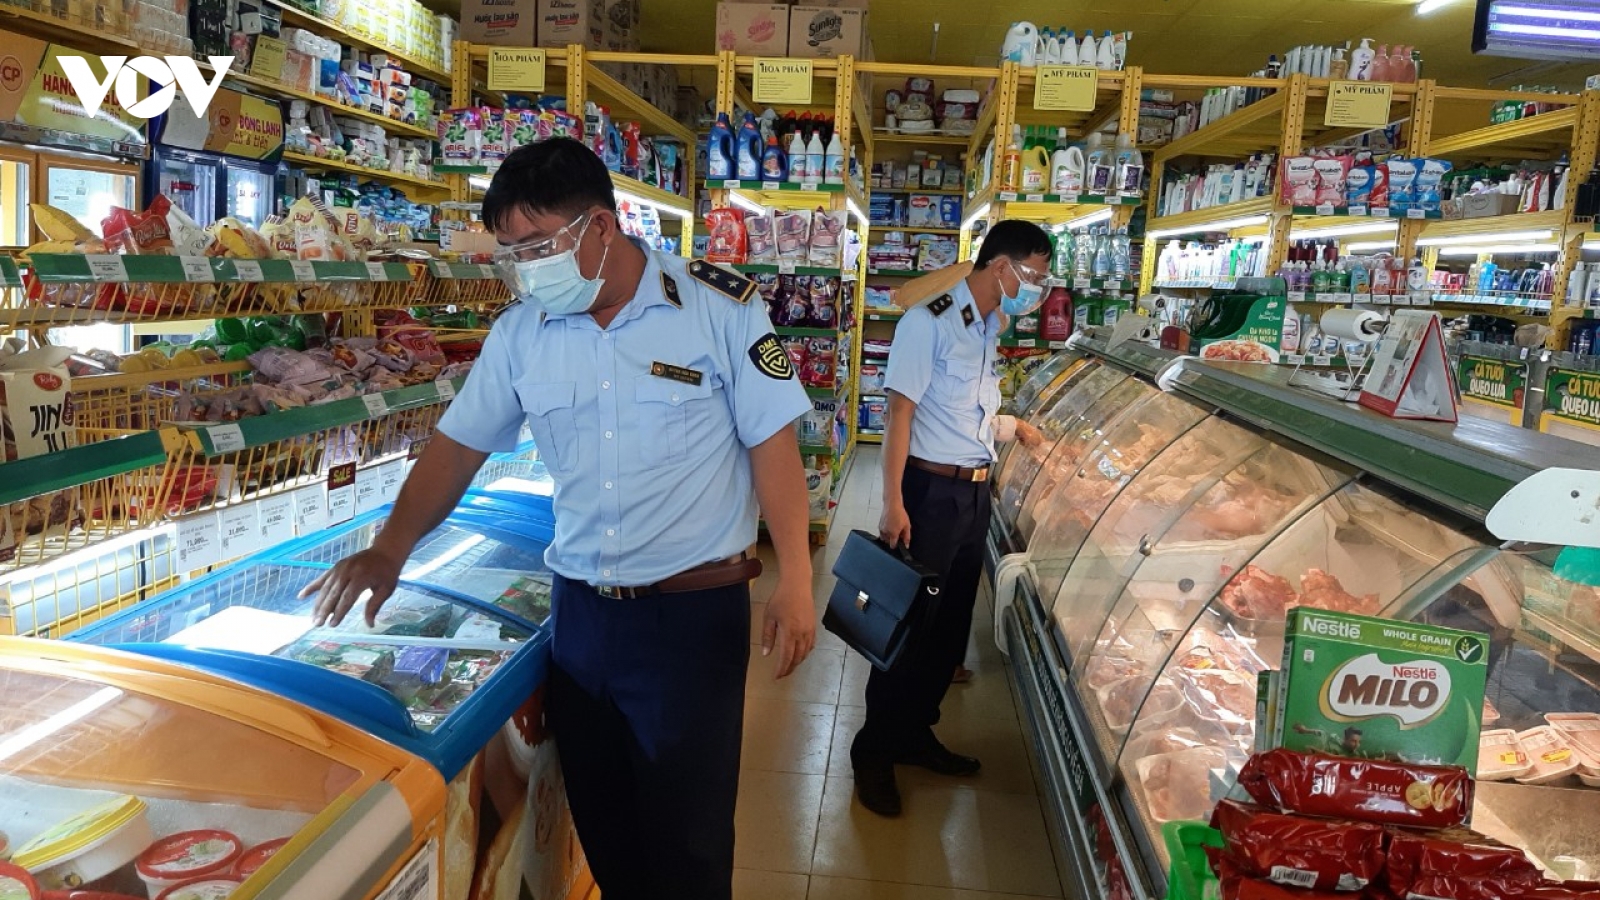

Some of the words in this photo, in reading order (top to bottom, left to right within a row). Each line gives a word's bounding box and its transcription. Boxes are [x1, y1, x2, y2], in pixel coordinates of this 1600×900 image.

[809, 15, 843, 37] Sunlight
[2, 65, 21, 82] CP
[445, 144, 467, 152] ARIEL
[814, 401, 836, 412] OMO
[30, 404, 62, 438] JIN
[1303, 616, 1361, 640] Nestlé
[1383, 628, 1417, 642] WHOLE
[1420, 634, 1452, 646] GRAIN
[1393, 665, 1437, 680] Nestlé
[1337, 673, 1440, 710] MILO
[1366, 781, 1402, 793] APPLE
